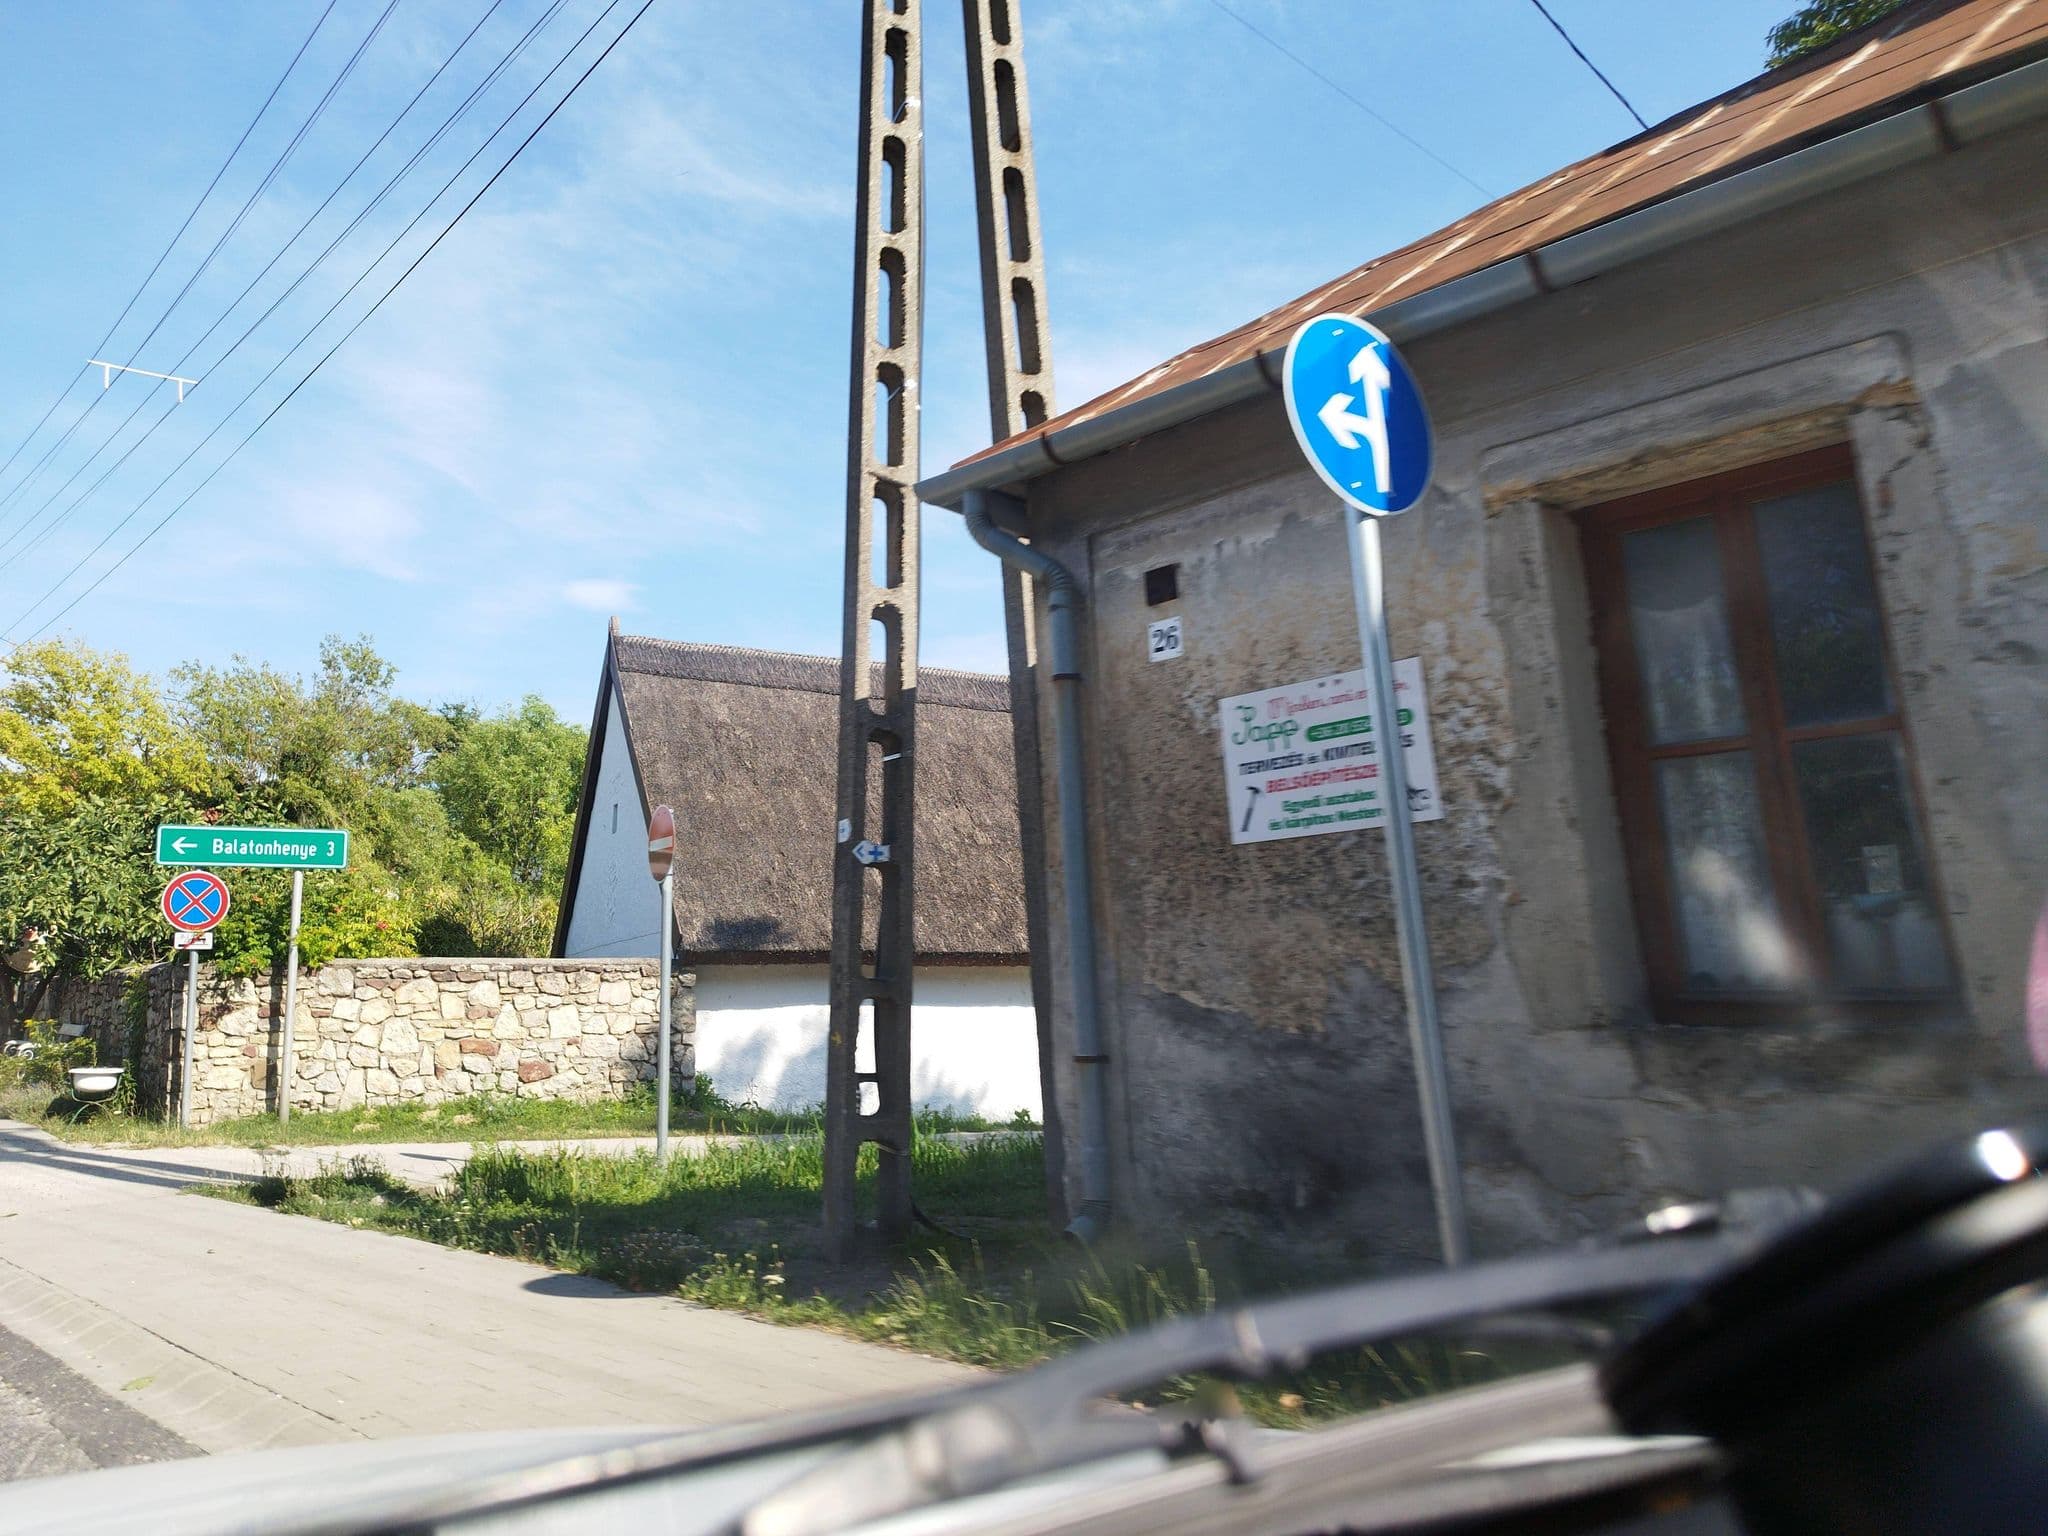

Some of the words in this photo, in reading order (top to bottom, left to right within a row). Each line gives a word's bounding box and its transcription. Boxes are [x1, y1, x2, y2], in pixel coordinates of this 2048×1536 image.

[1152, 625, 1178, 653] 26
[1231, 705, 1299, 752] Papp
[212, 838, 318, 860] Balatonhenye
[326, 841, 335, 857] 3
